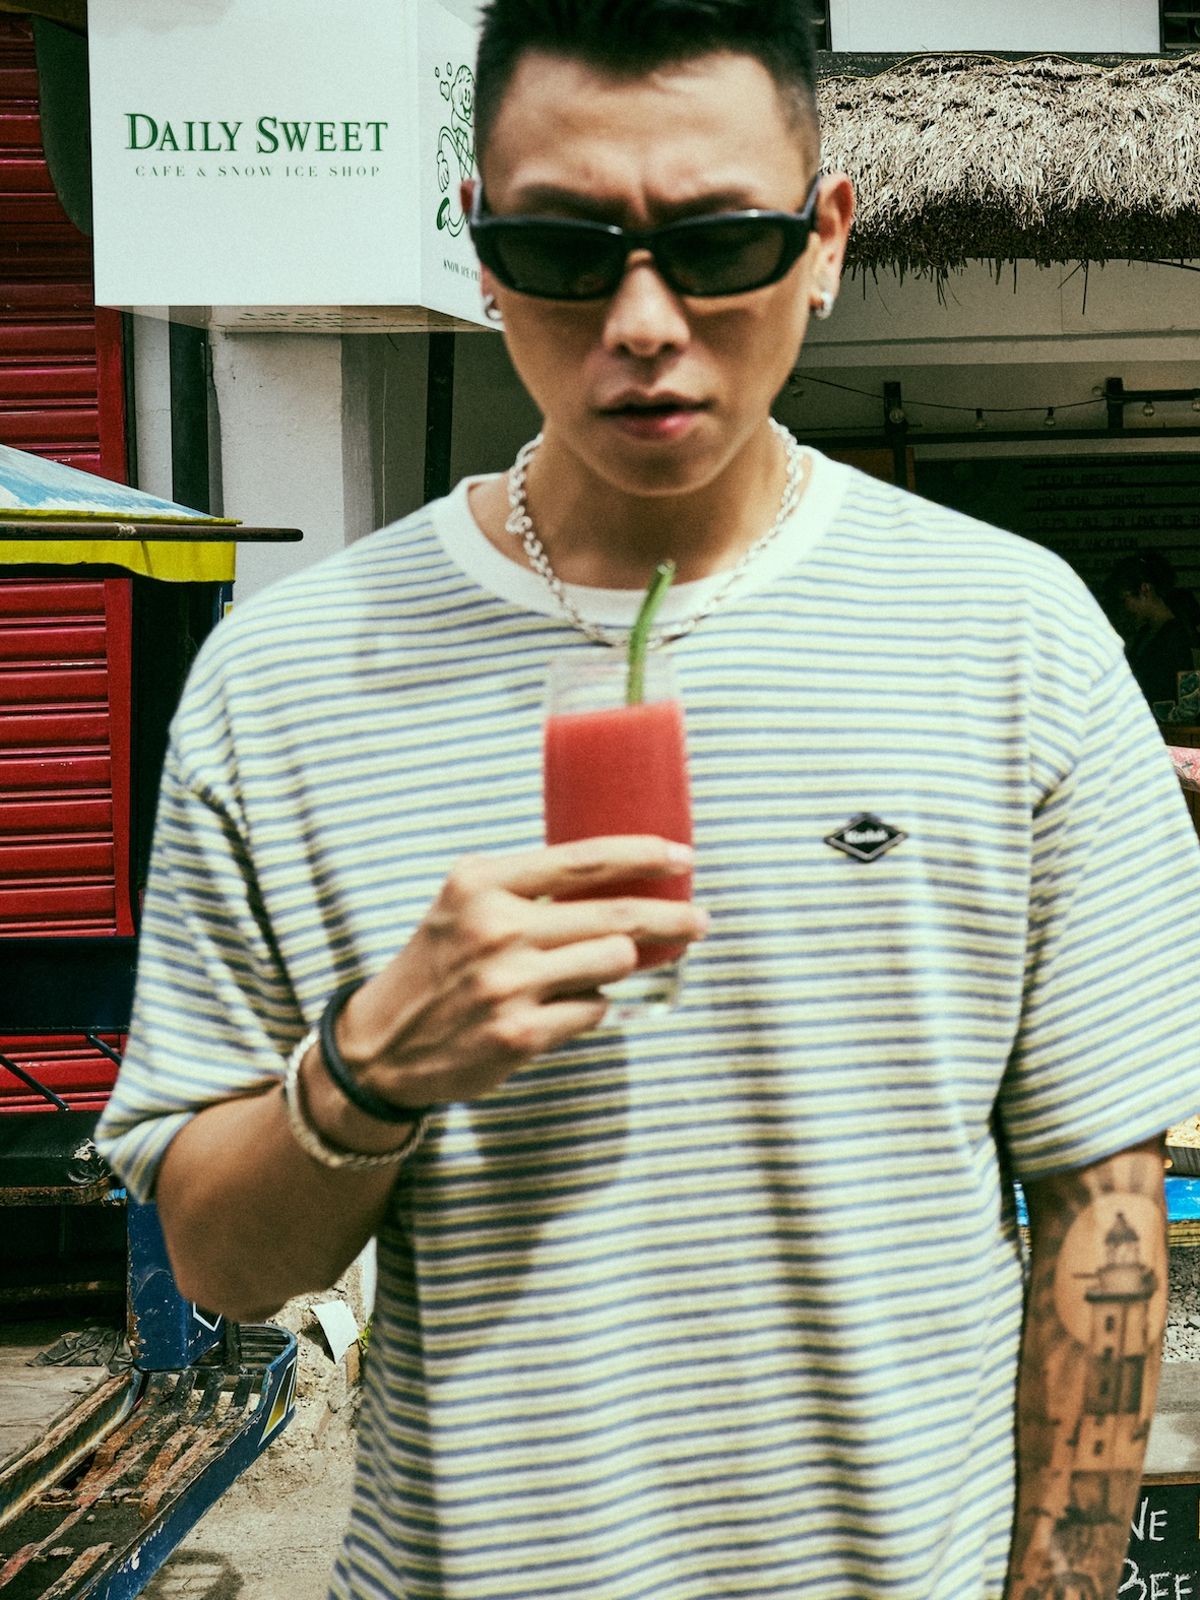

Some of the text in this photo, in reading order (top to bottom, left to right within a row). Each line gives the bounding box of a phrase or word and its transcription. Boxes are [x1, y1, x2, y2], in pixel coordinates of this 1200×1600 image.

[124, 113, 388, 154] DAILY SWEET
[136, 165, 380, 177] CAFE & SNOW ICE SHOP
